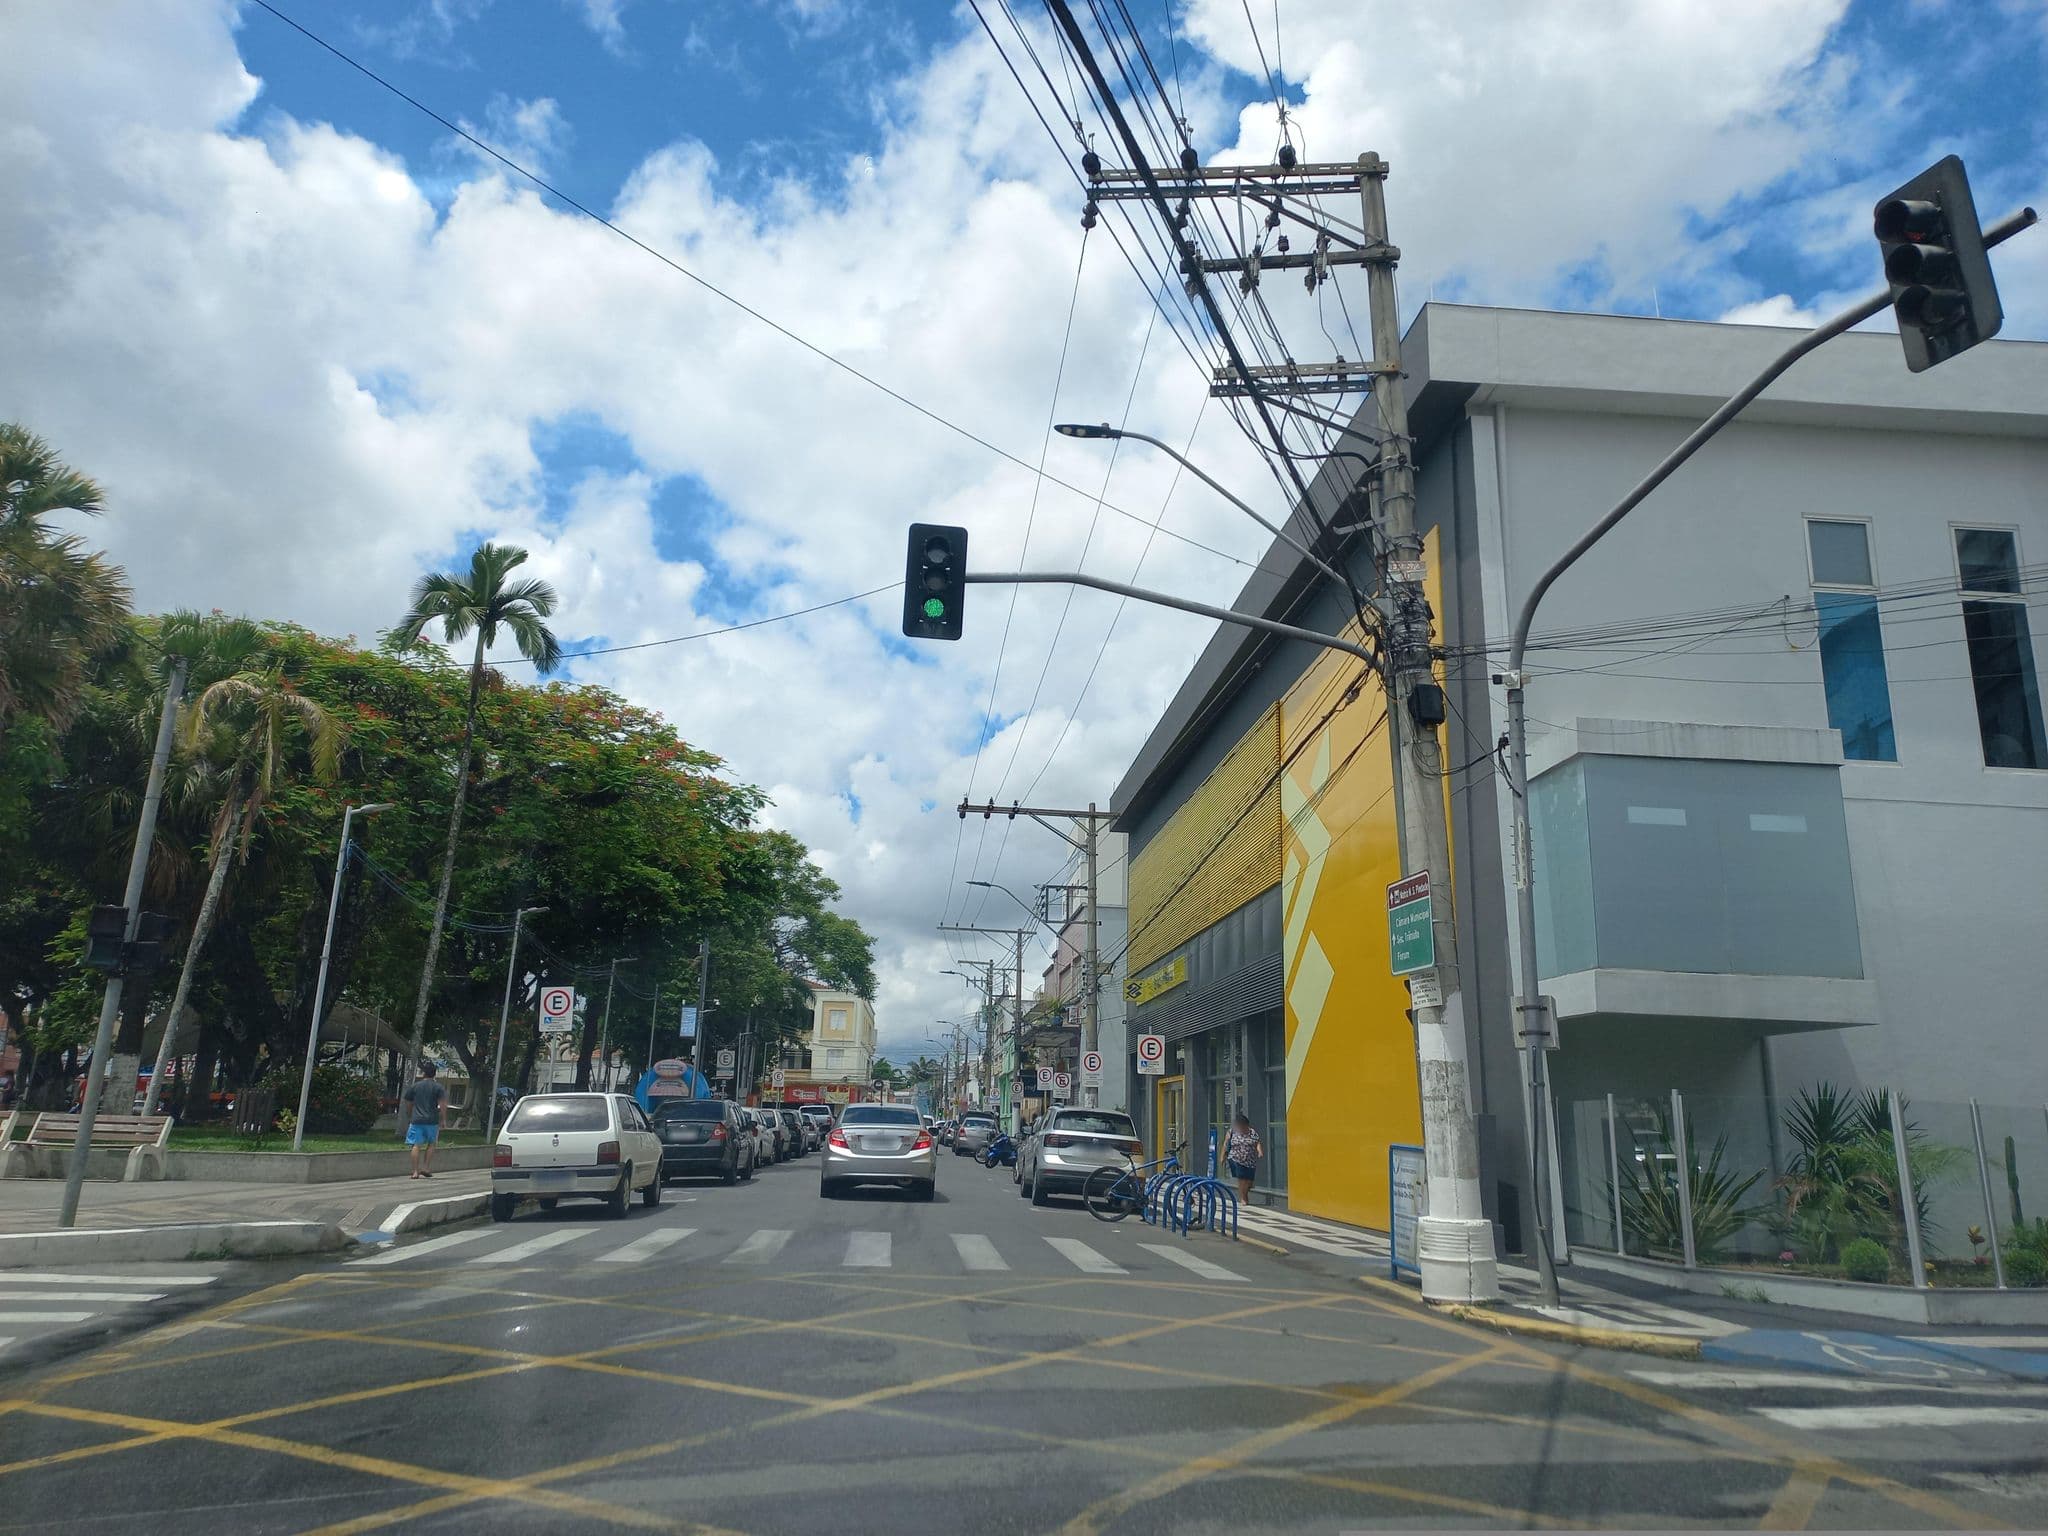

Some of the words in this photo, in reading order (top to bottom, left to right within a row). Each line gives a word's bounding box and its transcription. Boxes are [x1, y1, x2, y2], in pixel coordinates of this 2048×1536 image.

[1410, 911, 1429, 923] Municipal
[552, 996, 562, 1010] E
[1148, 1042, 1156, 1056] E
[723, 1055, 728, 1063] E
[1089, 1056, 1096, 1068] E
